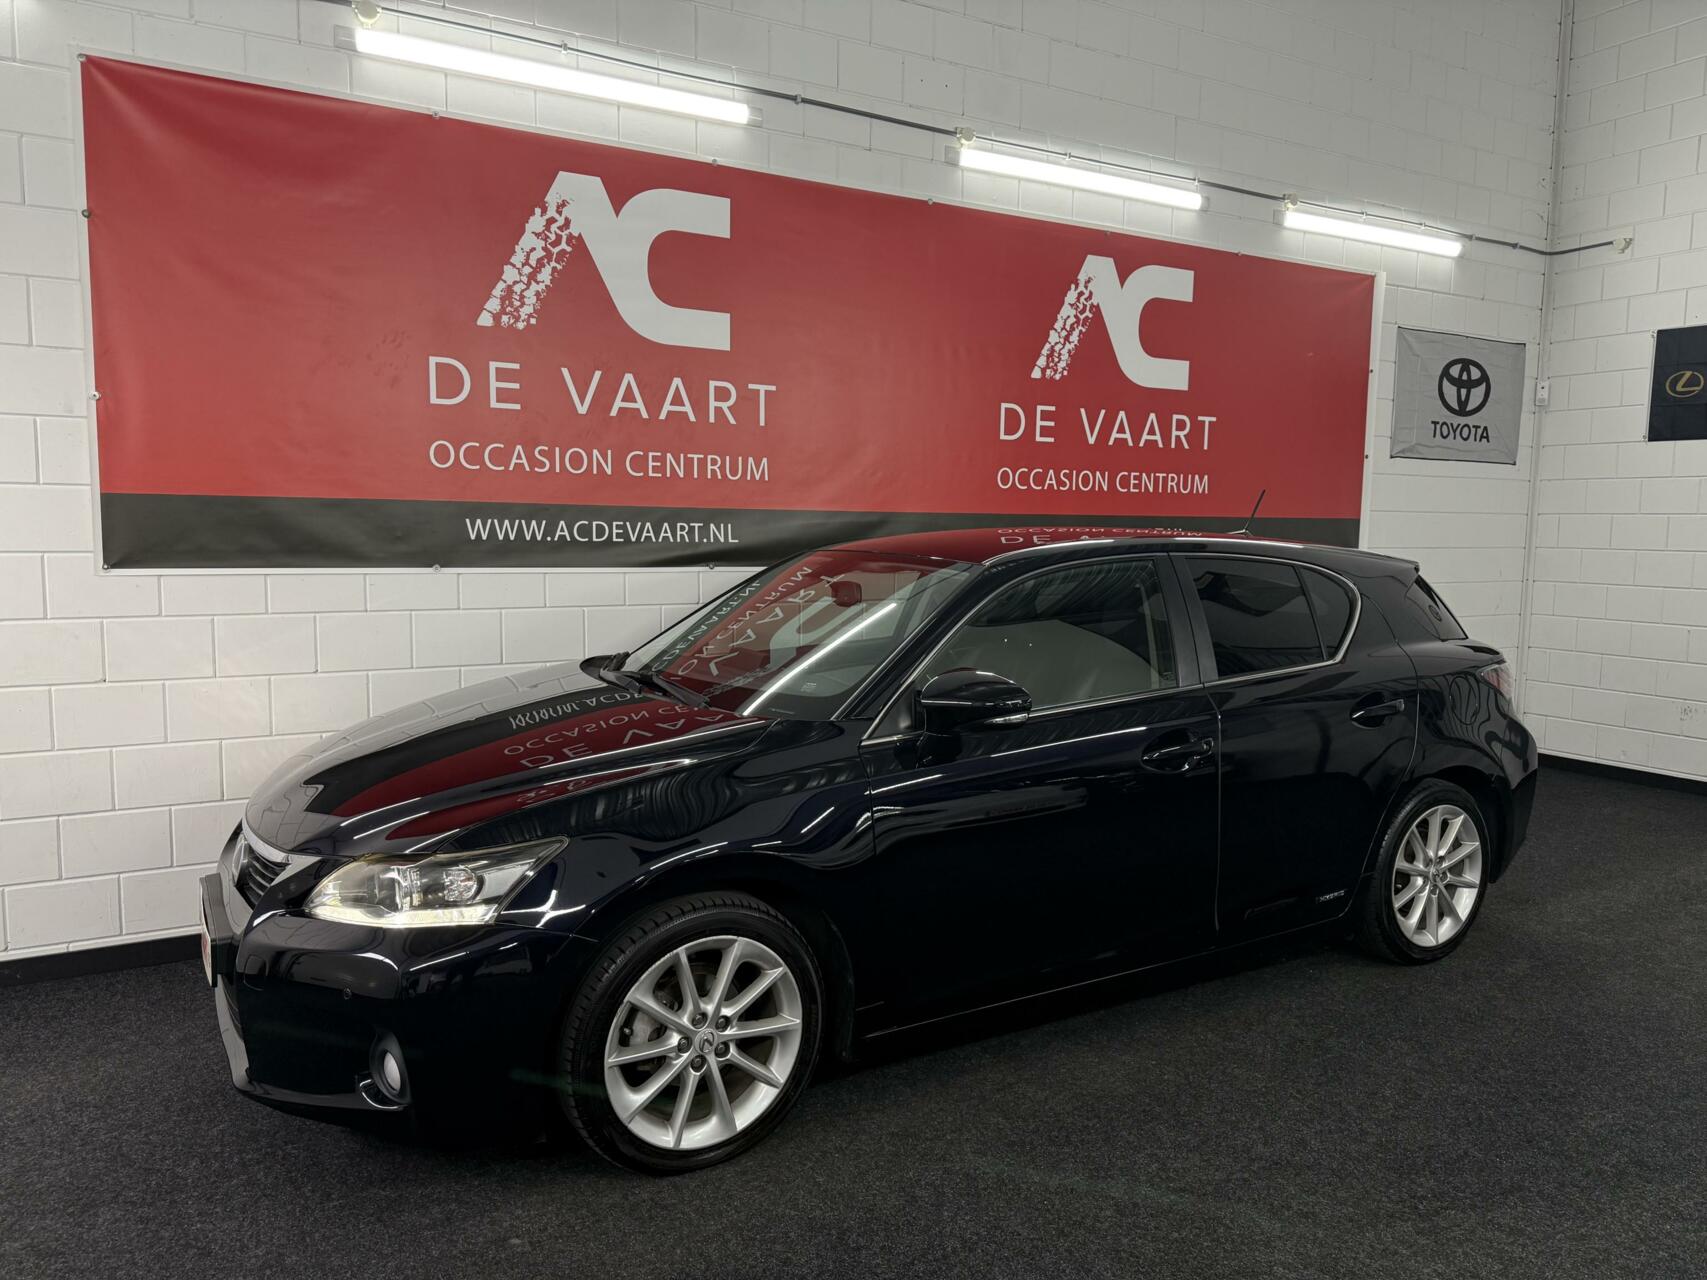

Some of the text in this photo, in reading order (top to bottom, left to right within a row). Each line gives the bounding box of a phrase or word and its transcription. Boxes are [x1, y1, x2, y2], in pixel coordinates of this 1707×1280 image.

[429, 355, 777, 427] DE VAART
[999, 402, 1217, 450] DE VAART
[1430, 420, 1490, 443] TOYOTA
[429, 440, 769, 481] OCCASION CENTRUM
[997, 467, 1209, 494] OCCASION CENTRUM
[465, 517, 739, 544] WWW.ACDEVAART.NL
